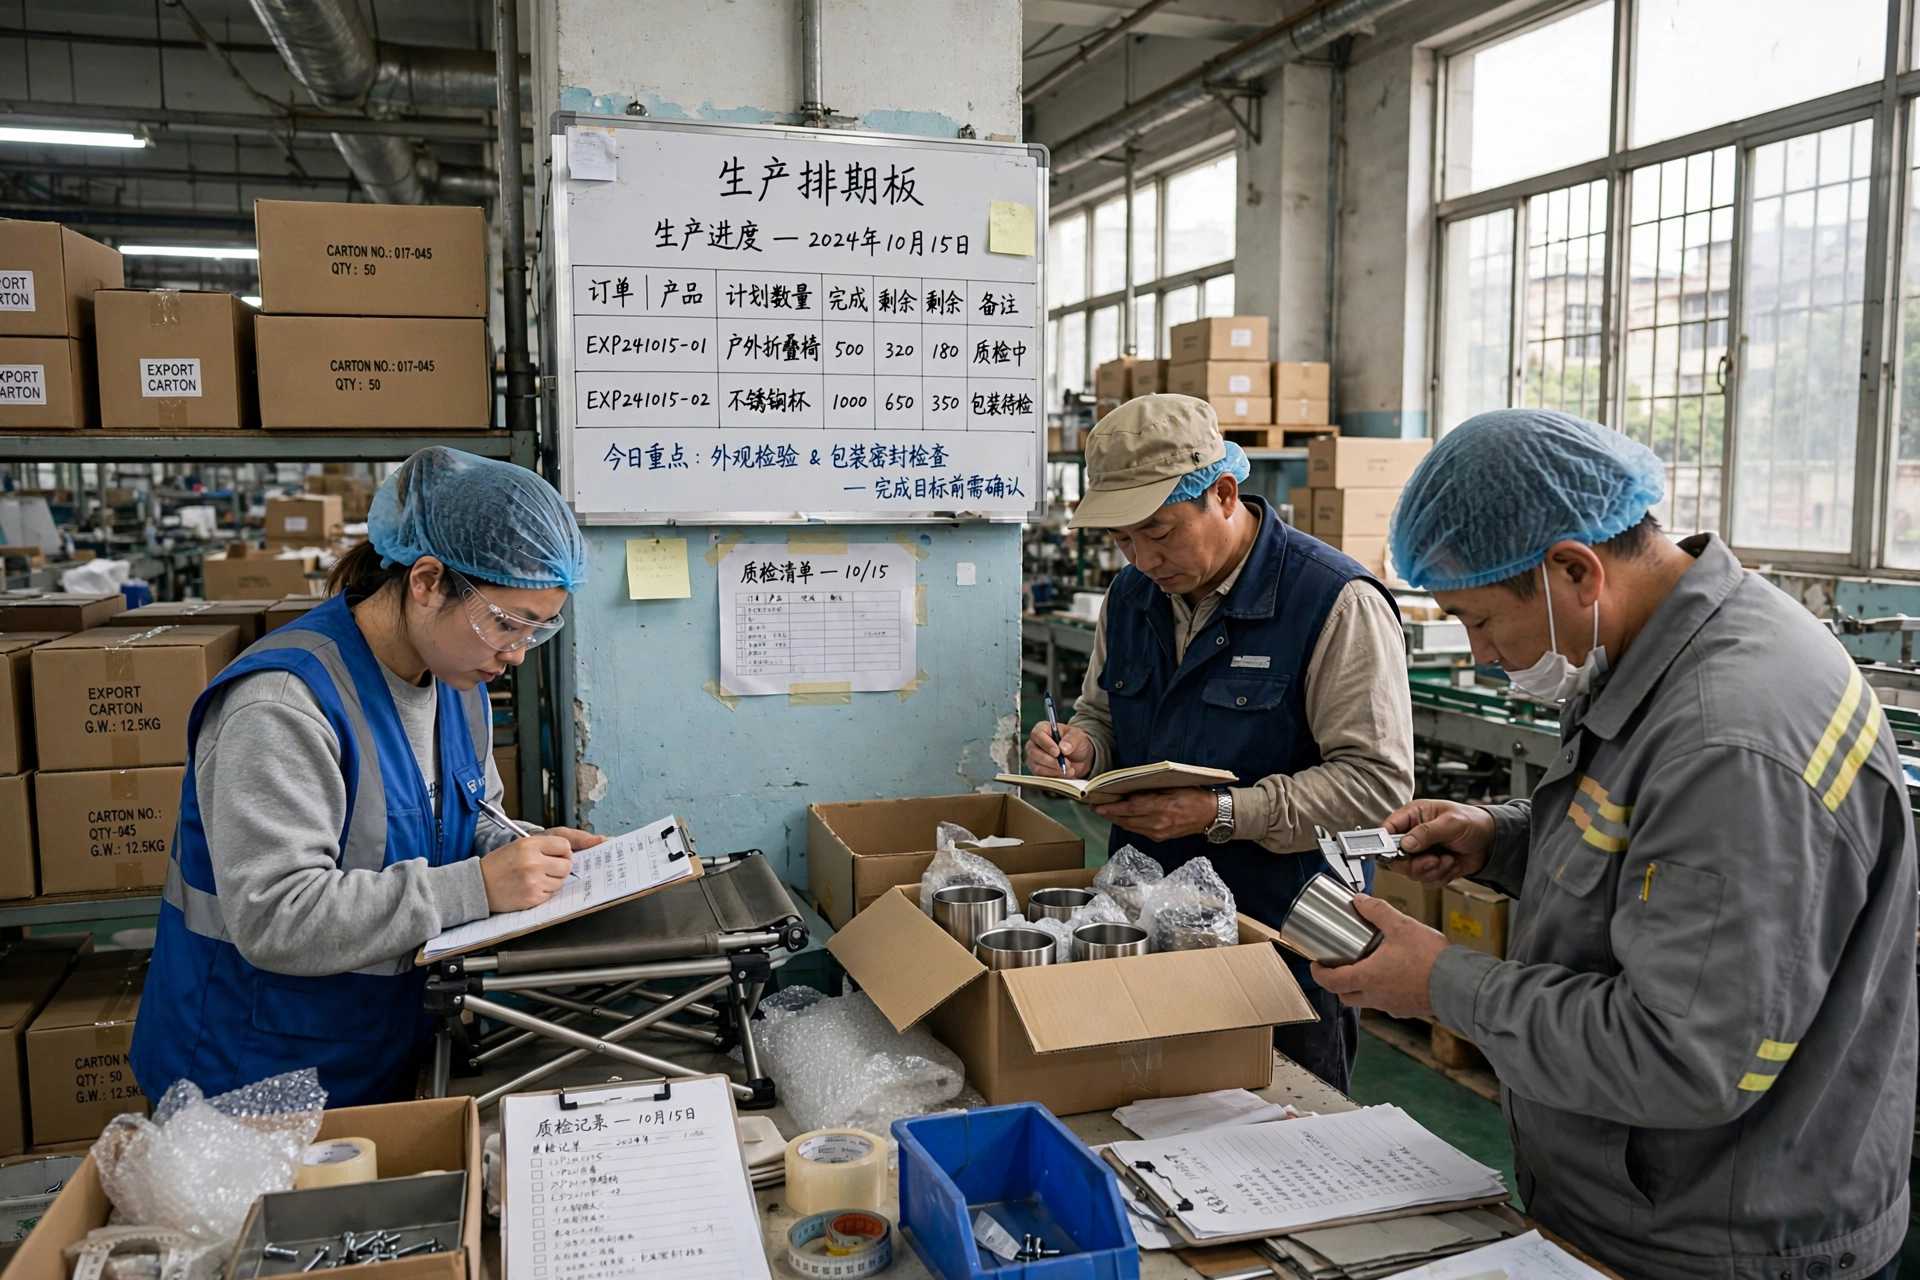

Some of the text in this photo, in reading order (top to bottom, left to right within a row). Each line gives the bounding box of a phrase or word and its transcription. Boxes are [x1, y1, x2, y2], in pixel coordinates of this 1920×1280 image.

[718, 156, 925, 207] 生产排期板
[654, 217, 763, 252] 生产进度
[808, 226, 969, 257] 2024年10月15日
[327, 244, 432, 259] CARTON NO.: 017-045
[364, 264, 376, 276] 50
[0, 277, 27, 289] ORT
[588, 277, 1019, 316] 订单 产品 计划数量 完成 剩余 剩余 备注
[586, 333, 1027, 367] EXP241015-01 户外折叠椅 500 320 180 质检中
[147, 364, 194, 376] EXPORT
[330, 359, 435, 372] CARTON NO.: 017-045
[148, 379, 196, 392] CARTON
[368, 379, 380, 390] 50
[587, 390, 710, 411] EXP241015-02
[833, 393, 867, 410] 1000
[885, 393, 914, 411] 650
[932, 395, 959, 411] 350
[971, 391, 1033, 416] 包装待检
[711, 443, 800, 472] 外观检验
[809, 449, 821, 465] &
[830, 443, 950, 470] 包装密封检查
[875, 474, 1025, 500] 完成目标前需确认
[740, 560, 814, 585] 质检清单
[845, 560, 889, 583] 10/15
[88, 685, 141, 700] EXPORT
[89, 702, 143, 716] CARTON
[85, 717, 161, 734] G.W.: 12.5KG
[88, 807, 162, 823] CARTON NO.:
[90, 839, 165, 857] G.W.: 12.5KG
[75, 1054, 120, 1070] CARTON
[109, 1070, 122, 1082] 50
[76, 1089, 106, 1103] G.W.:
[638, 1107, 696, 1125] 10月15日
